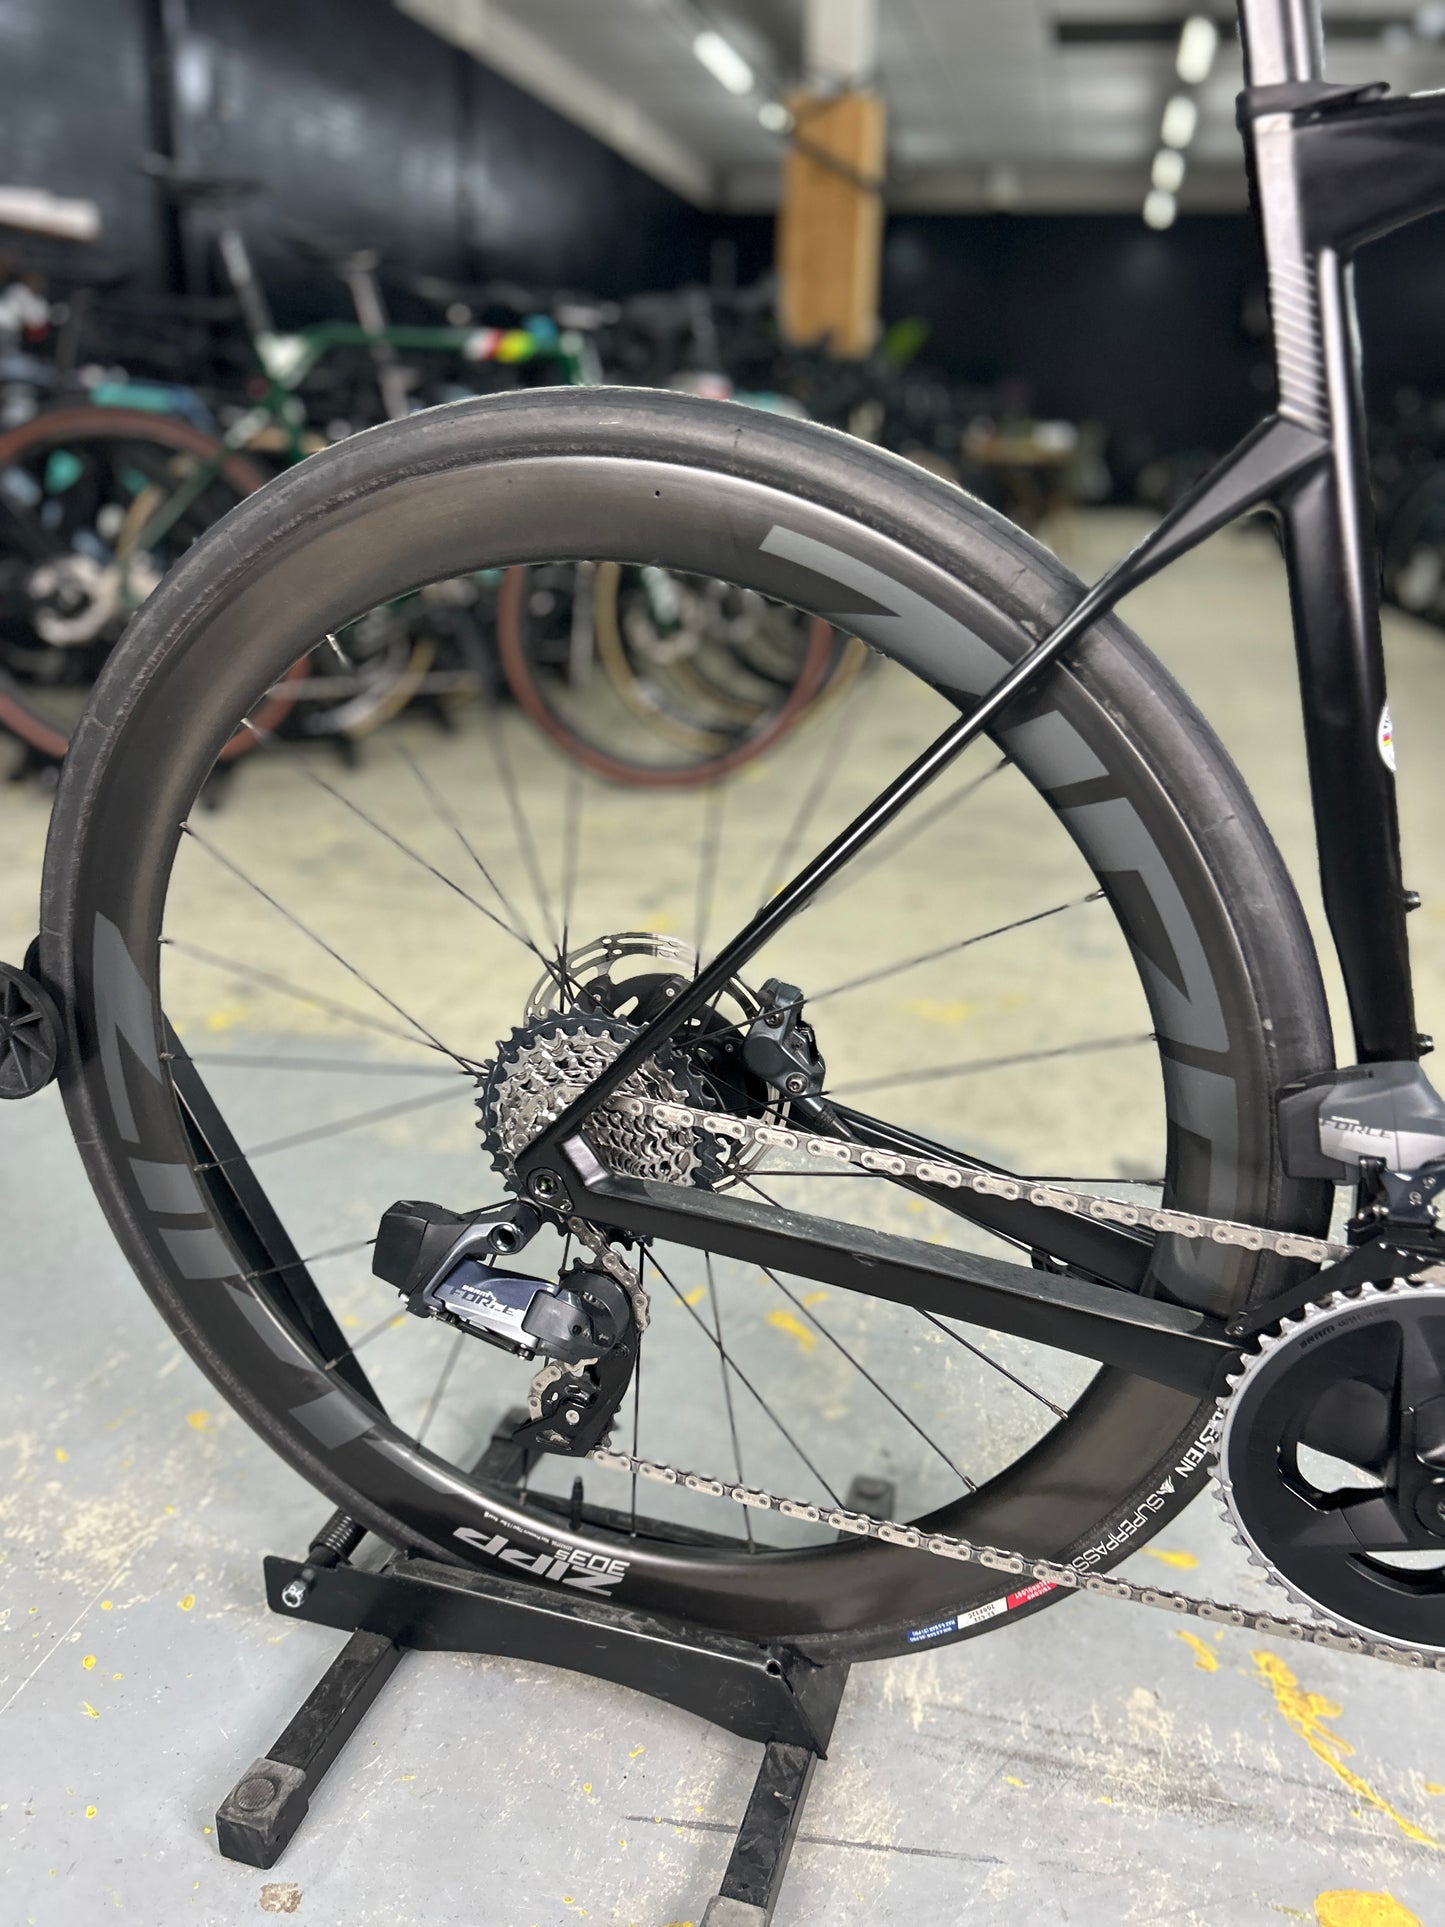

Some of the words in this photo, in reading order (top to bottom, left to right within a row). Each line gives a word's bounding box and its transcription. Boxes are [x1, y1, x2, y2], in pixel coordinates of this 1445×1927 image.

[759, 525, 1240, 1290] ZIPP
[1321, 1118, 1392, 1139] FORCE
[93, 911, 463, 1494] ZIPP
[450, 1286, 514, 1317] FORCE
[453, 1527, 623, 1597] ZIPP
